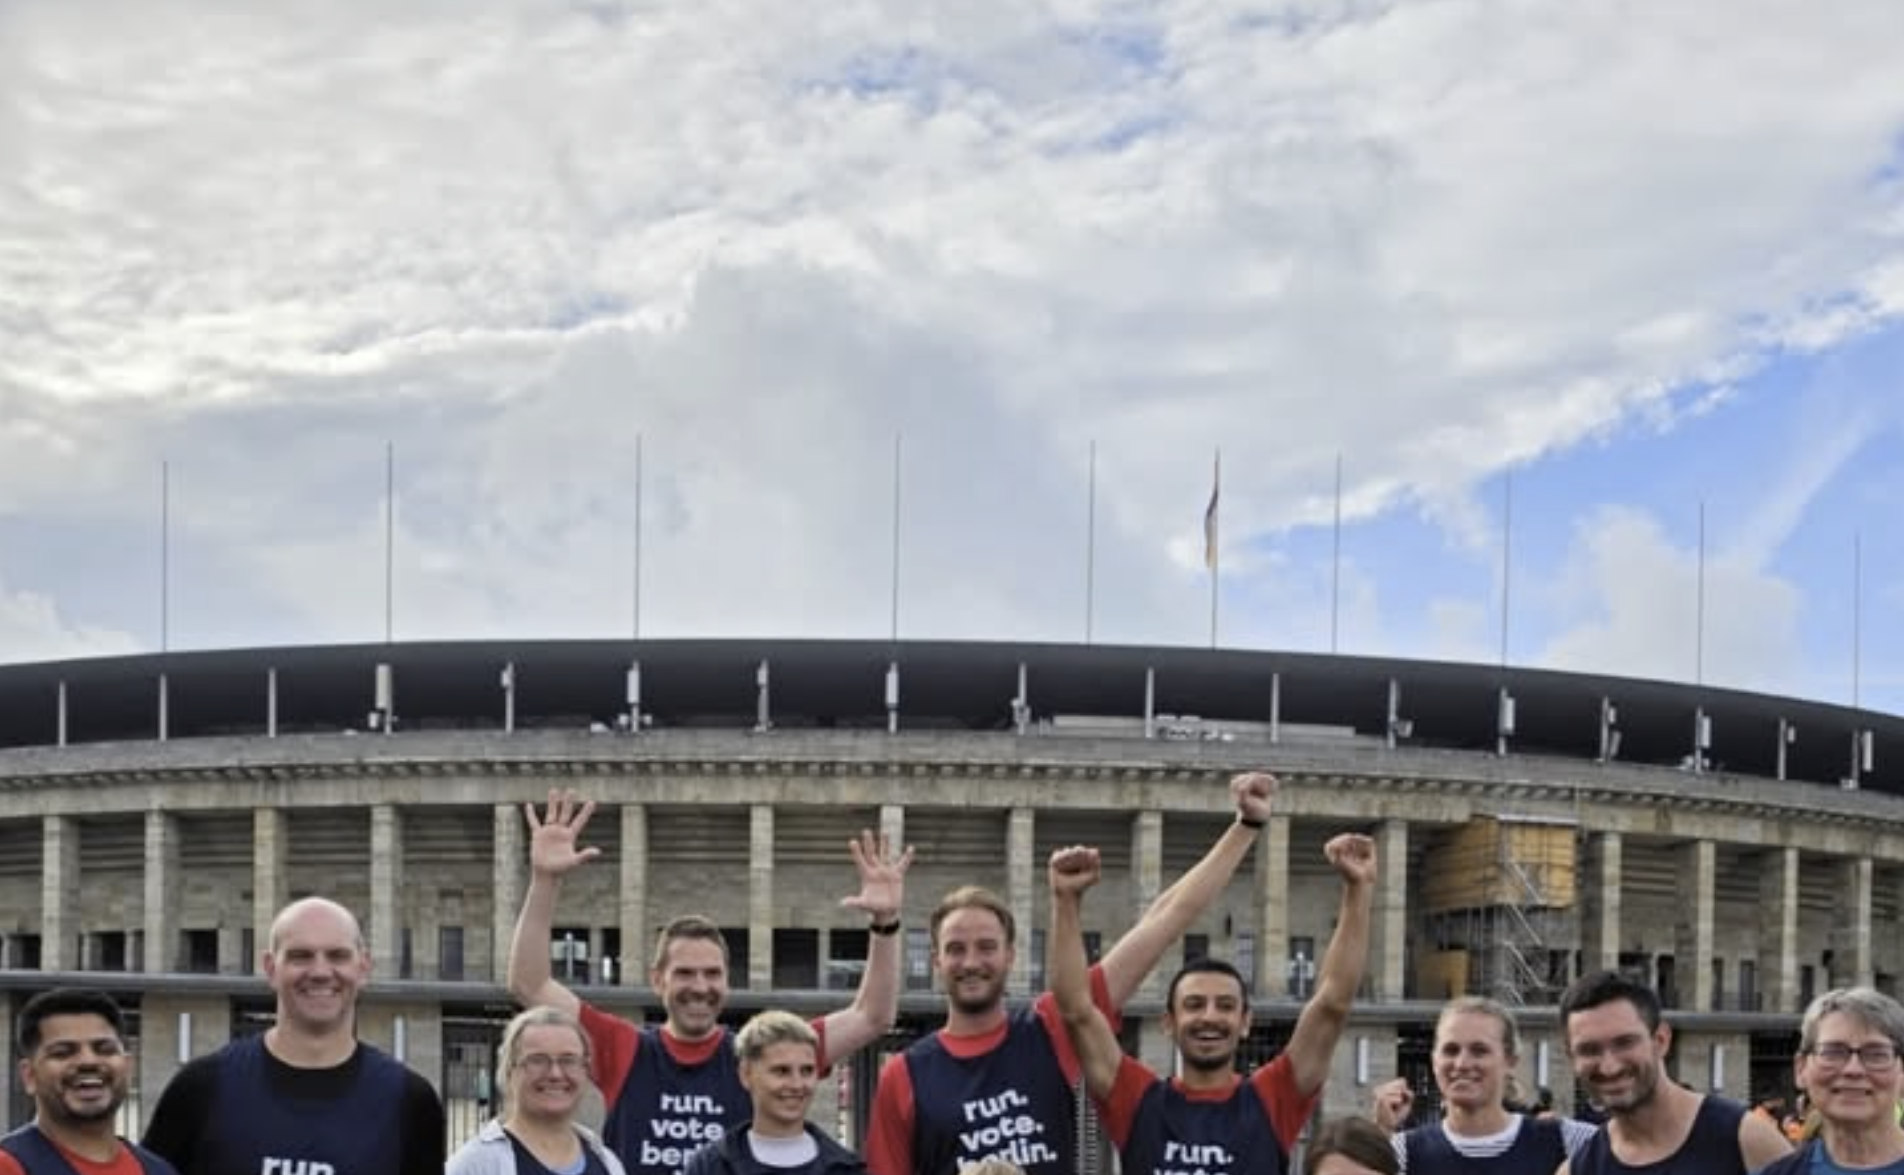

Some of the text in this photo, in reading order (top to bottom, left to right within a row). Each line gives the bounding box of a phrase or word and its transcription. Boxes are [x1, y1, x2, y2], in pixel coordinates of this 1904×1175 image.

[660, 1092, 725, 1115] run.
[963, 1088, 1029, 1122] run.
[650, 1117, 726, 1142] vote
[959, 1115, 1044, 1152] vote.
[1164, 1140, 1234, 1165] run.
